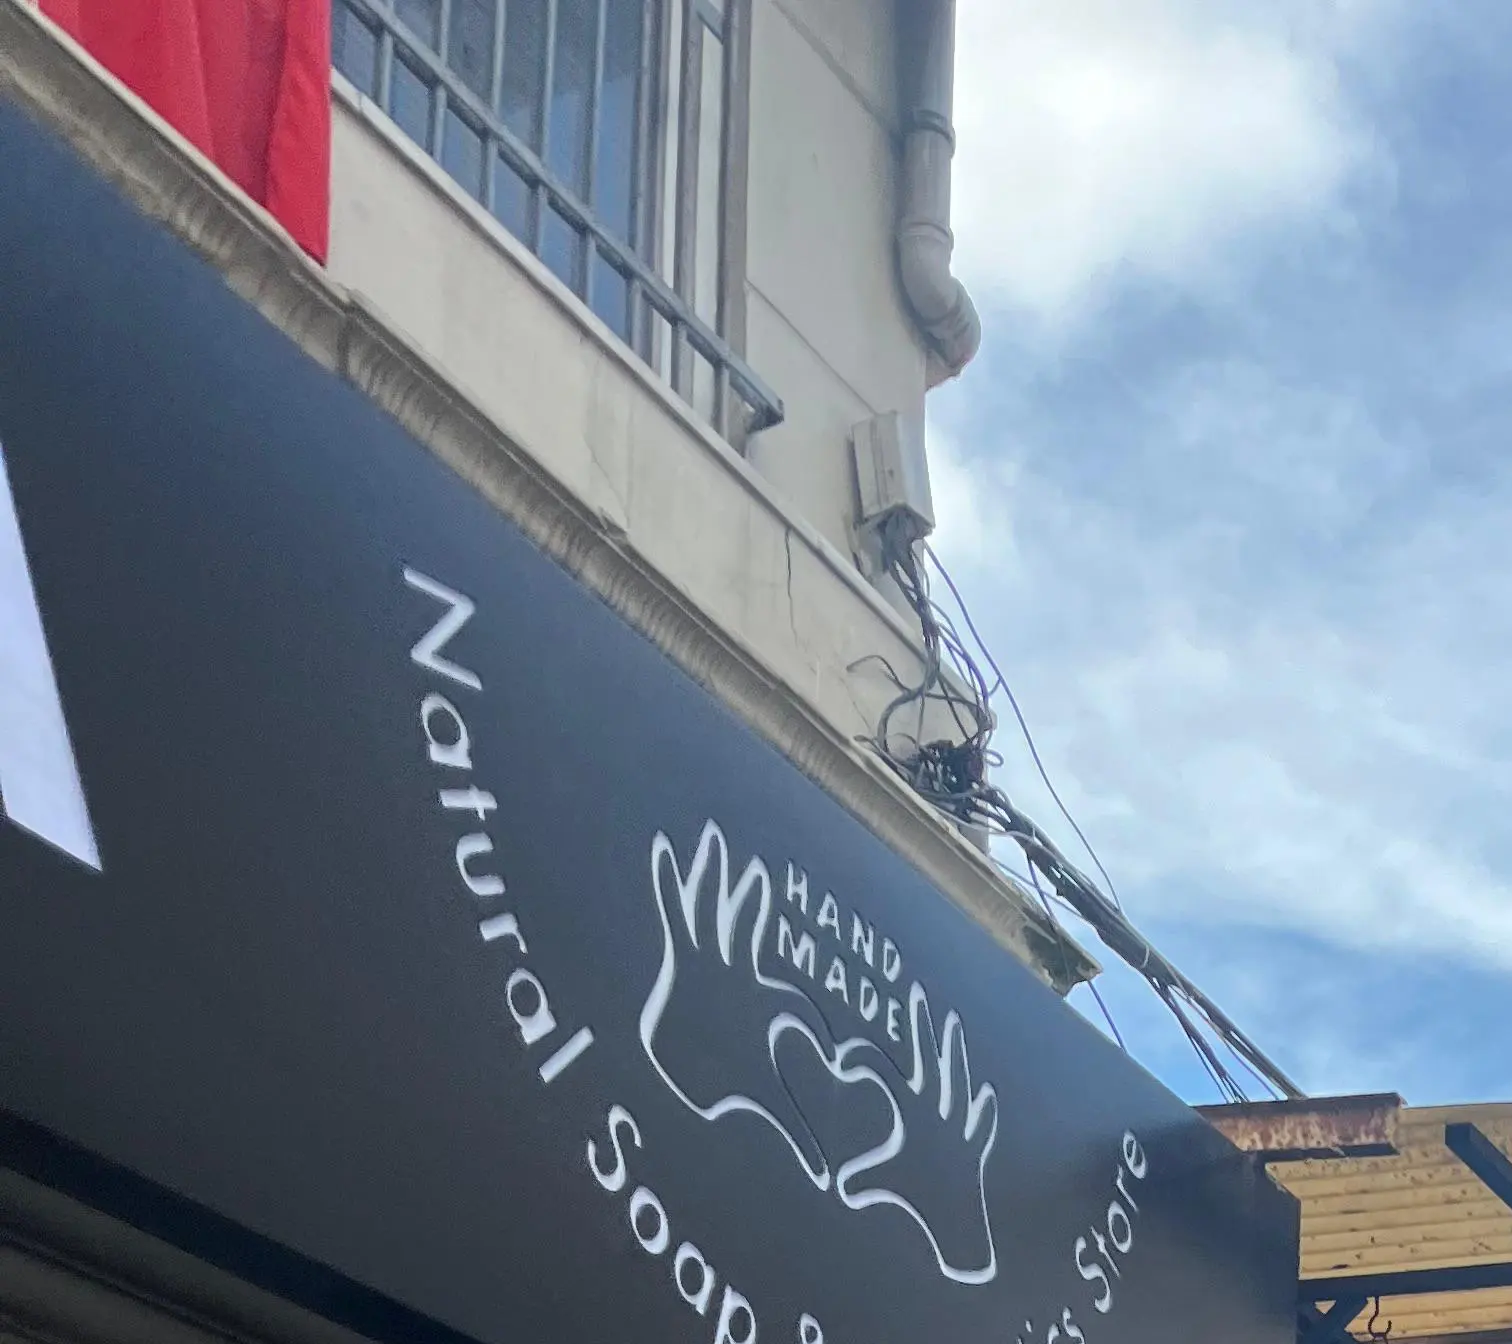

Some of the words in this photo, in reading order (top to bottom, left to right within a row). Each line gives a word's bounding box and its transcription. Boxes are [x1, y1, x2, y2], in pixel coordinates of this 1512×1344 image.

[402, 563, 595, 1083] Natural
[1074, 1130, 1148, 1313] Store
[778, 912, 902, 1041] MADE
[786, 858, 901, 983] HAND
